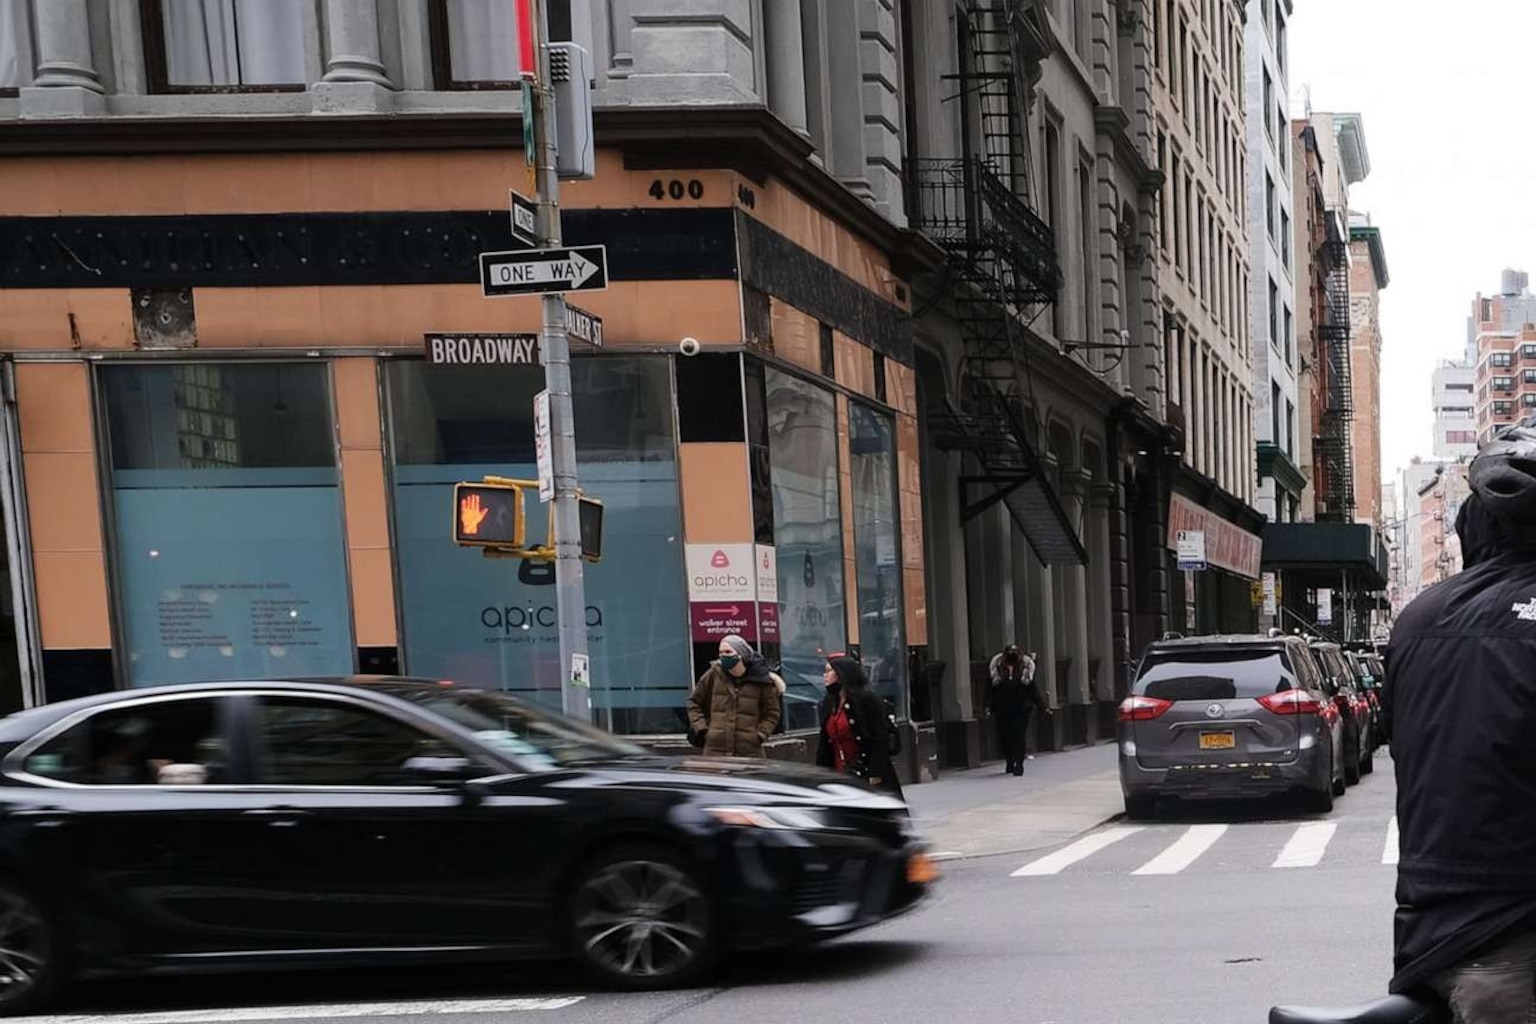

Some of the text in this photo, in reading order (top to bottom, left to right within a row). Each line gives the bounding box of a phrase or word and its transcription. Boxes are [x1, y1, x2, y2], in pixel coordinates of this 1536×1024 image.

[649, 180, 704, 200] 400
[500, 261, 587, 283] ONE WAY
[566, 309, 602, 347] ALKER ST
[431, 338, 535, 364] BROADWAY
[694, 574, 748, 588] apicha
[481, 599, 603, 635] apica
